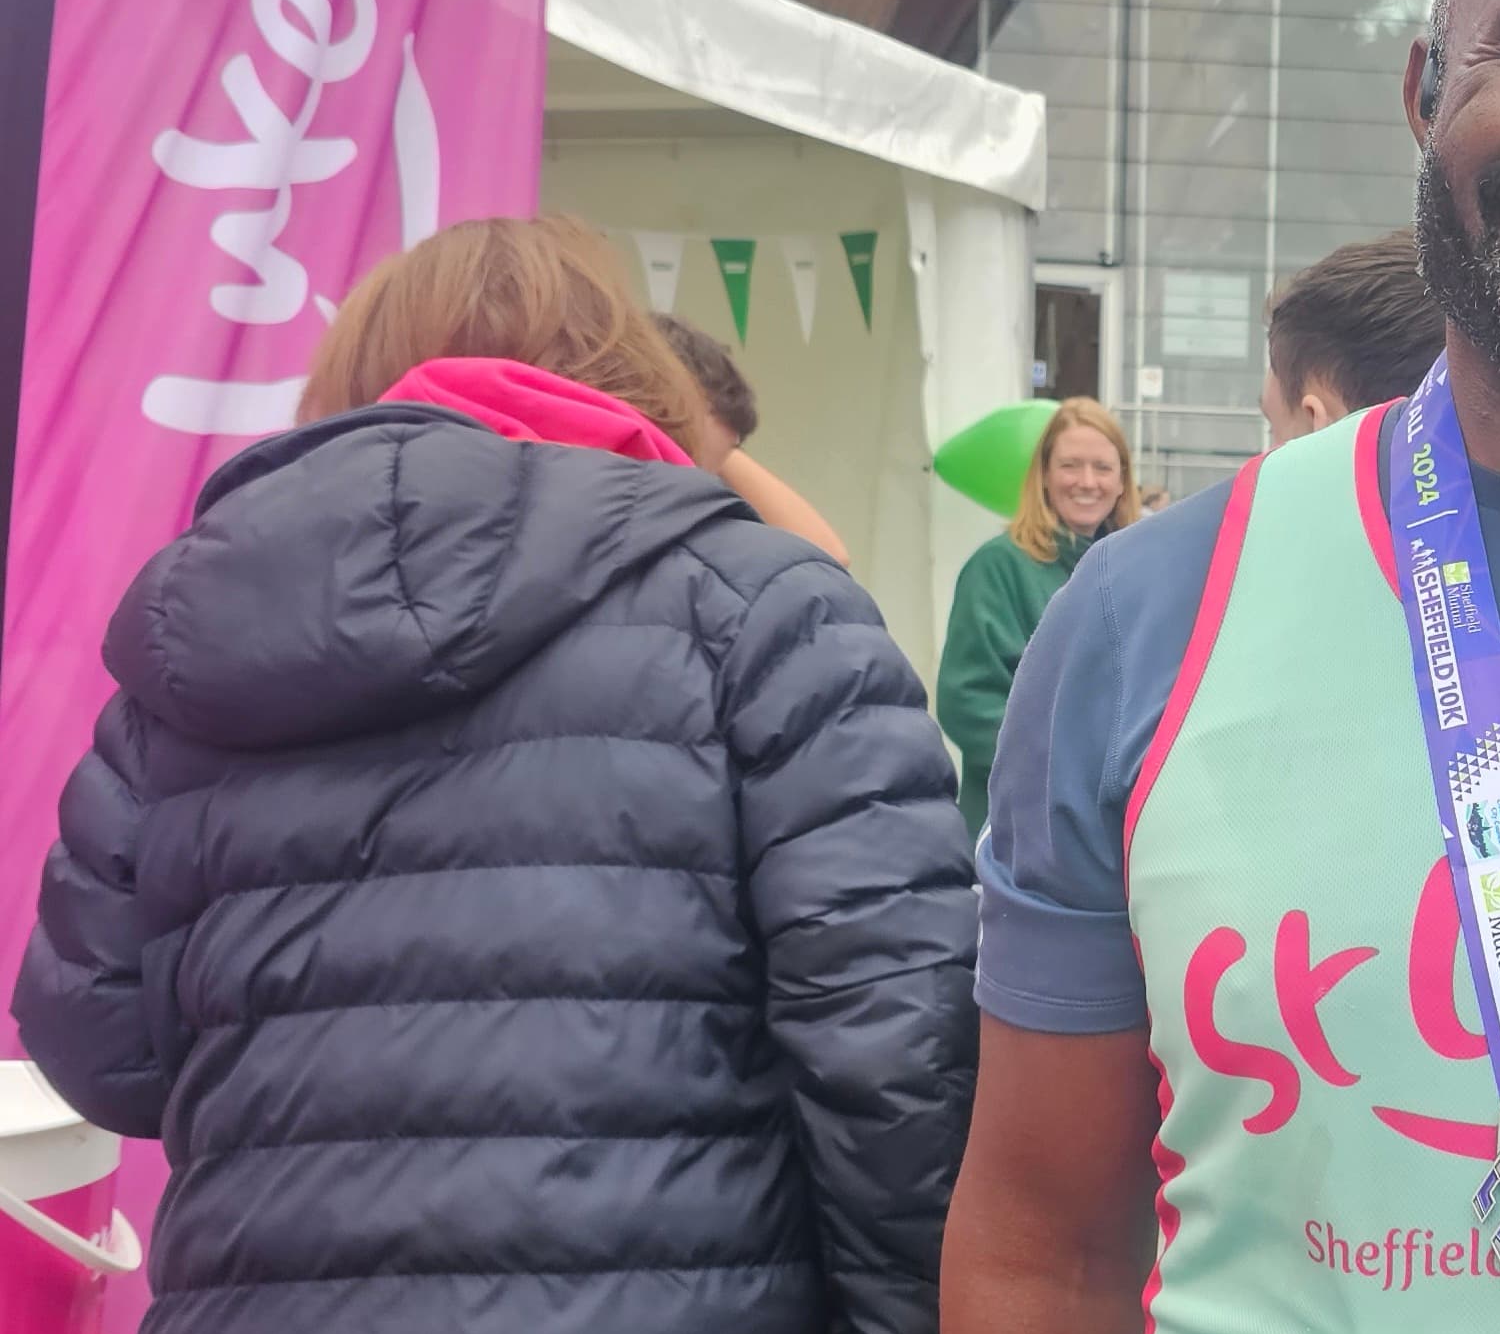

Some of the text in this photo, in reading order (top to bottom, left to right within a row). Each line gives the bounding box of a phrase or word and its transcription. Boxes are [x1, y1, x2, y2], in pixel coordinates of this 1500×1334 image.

[1411, 443, 1441, 506] 2024
[1446, 585, 1462, 629] Mutual
[1458, 582, 1482, 634] Sheffield
[1416, 571, 1465, 727] SHEFFIELD 10K
[1183, 908, 1380, 1135] St
